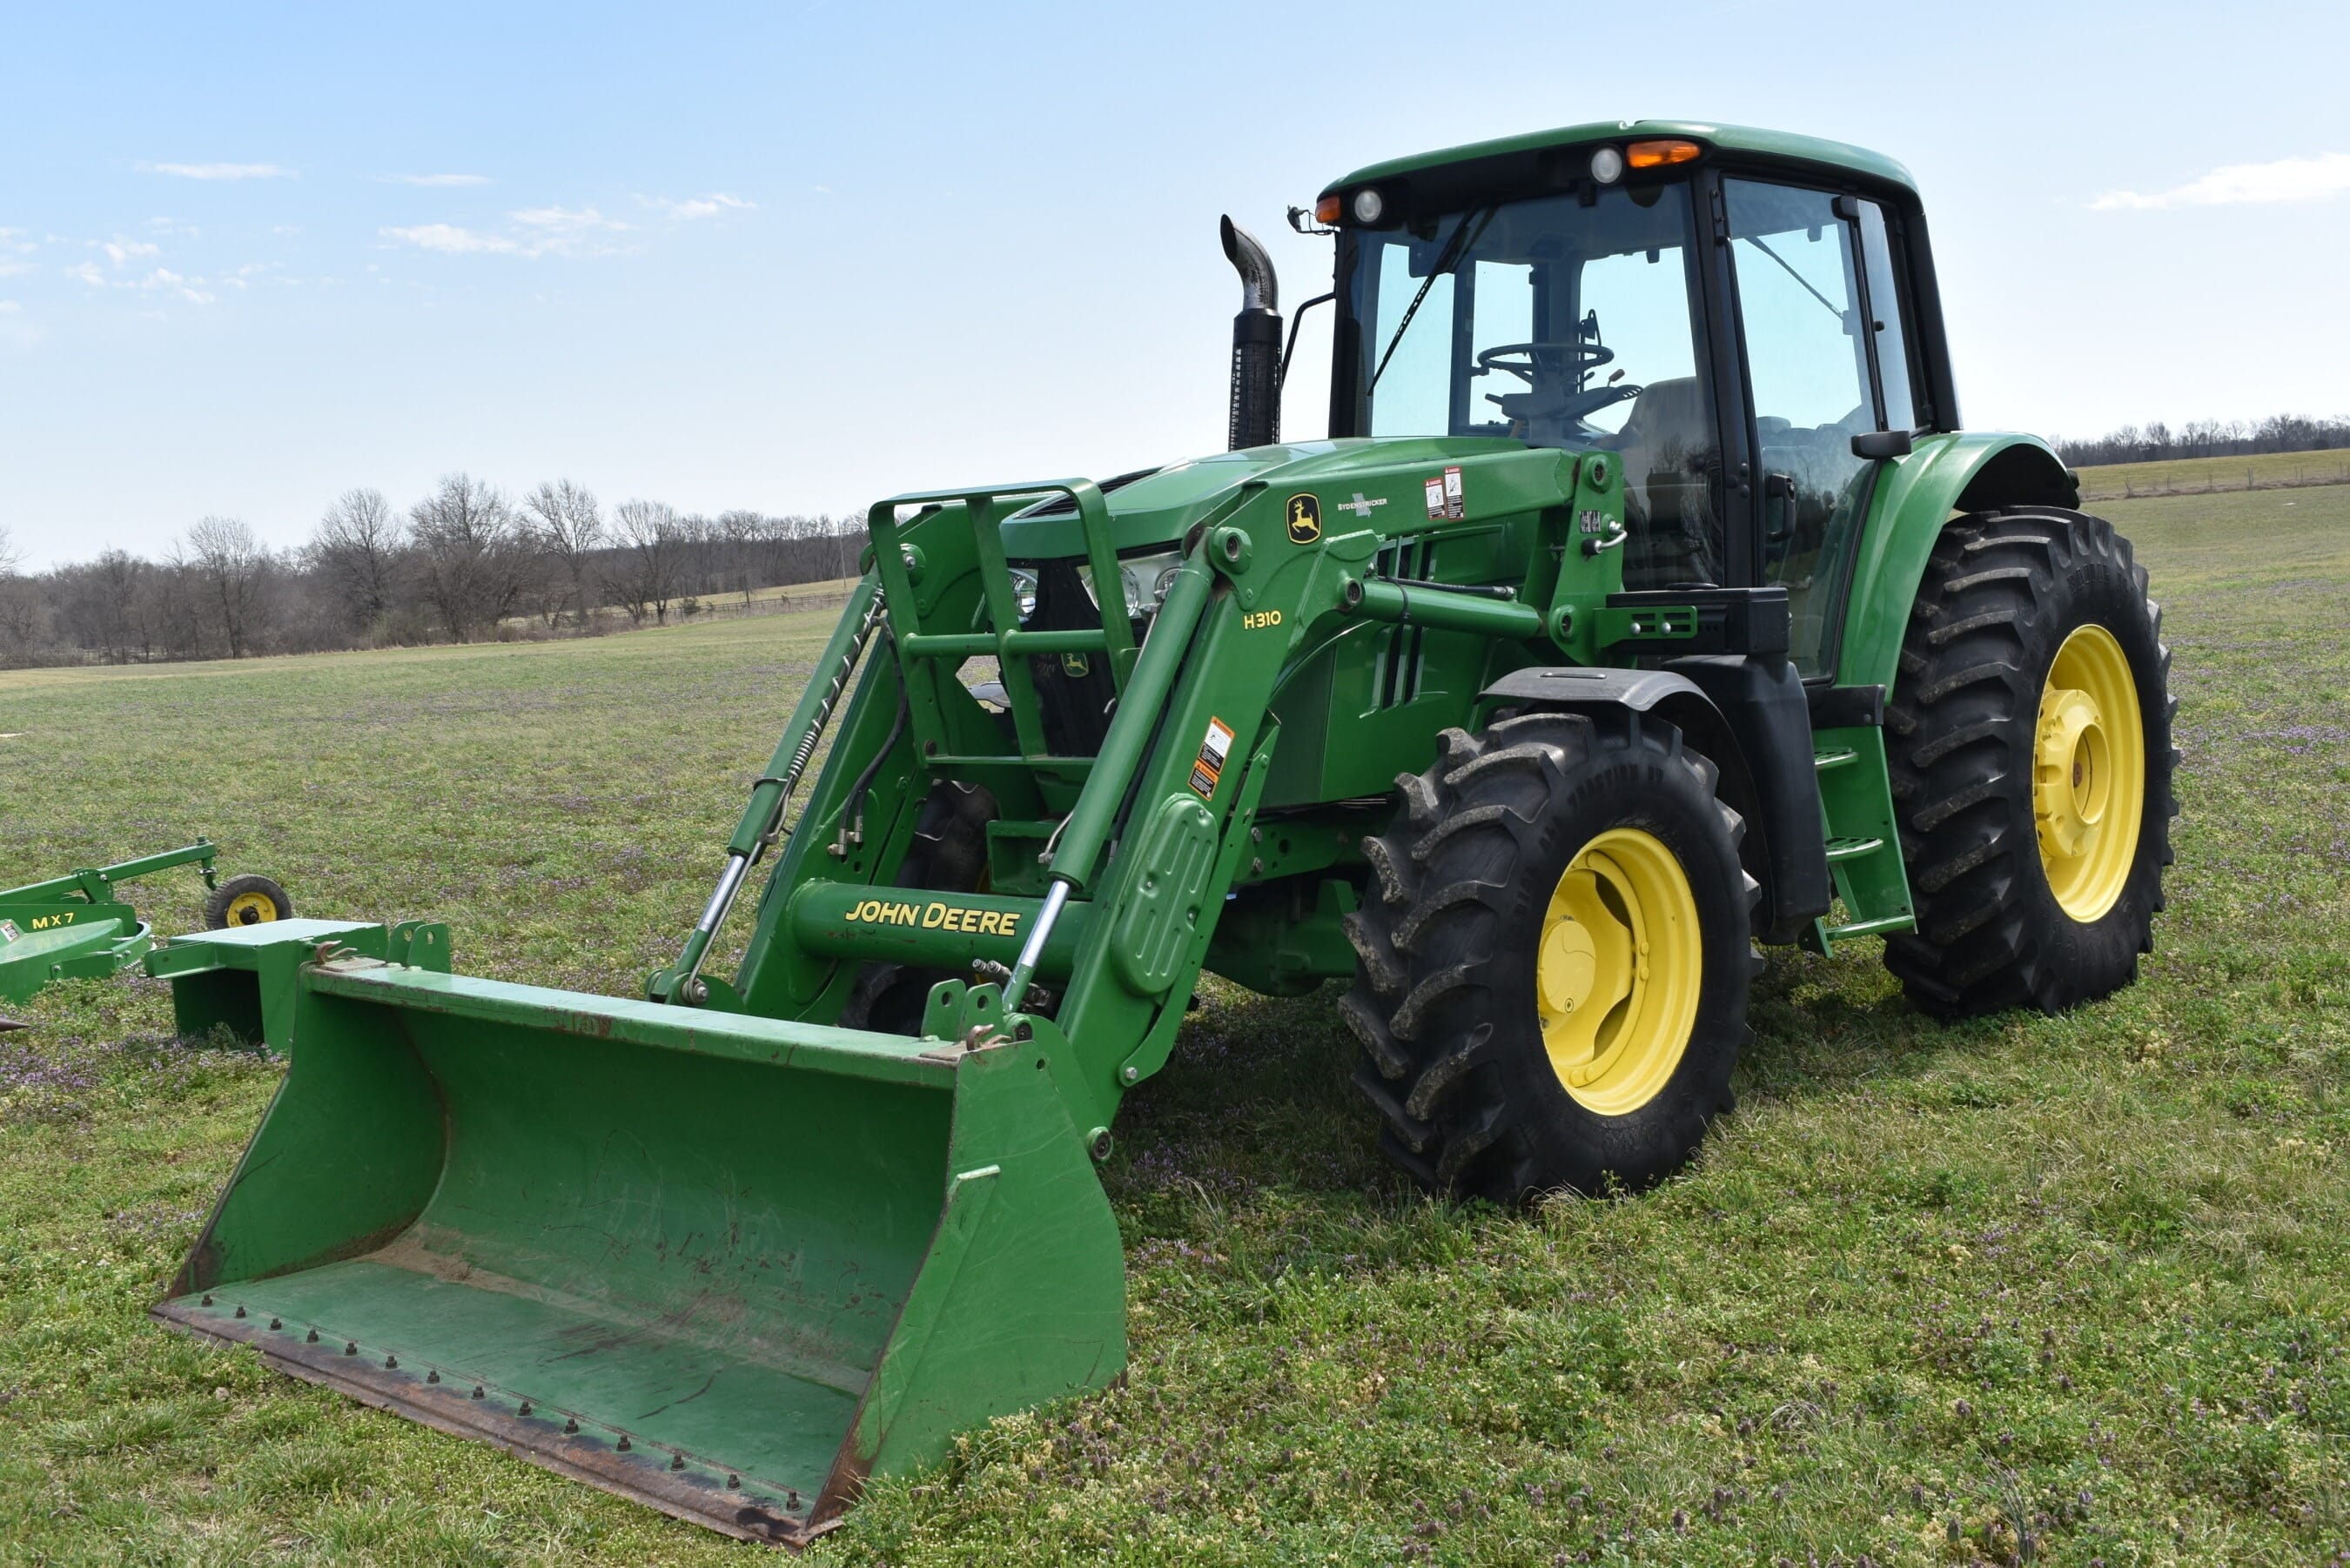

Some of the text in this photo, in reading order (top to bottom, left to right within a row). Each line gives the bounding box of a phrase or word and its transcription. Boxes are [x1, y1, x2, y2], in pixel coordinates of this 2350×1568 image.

[1337, 498, 1387, 511] SYDENSTRICKER
[1244, 610, 1281, 630] H310
[844, 901, 1021, 936] JOHN DEERE
